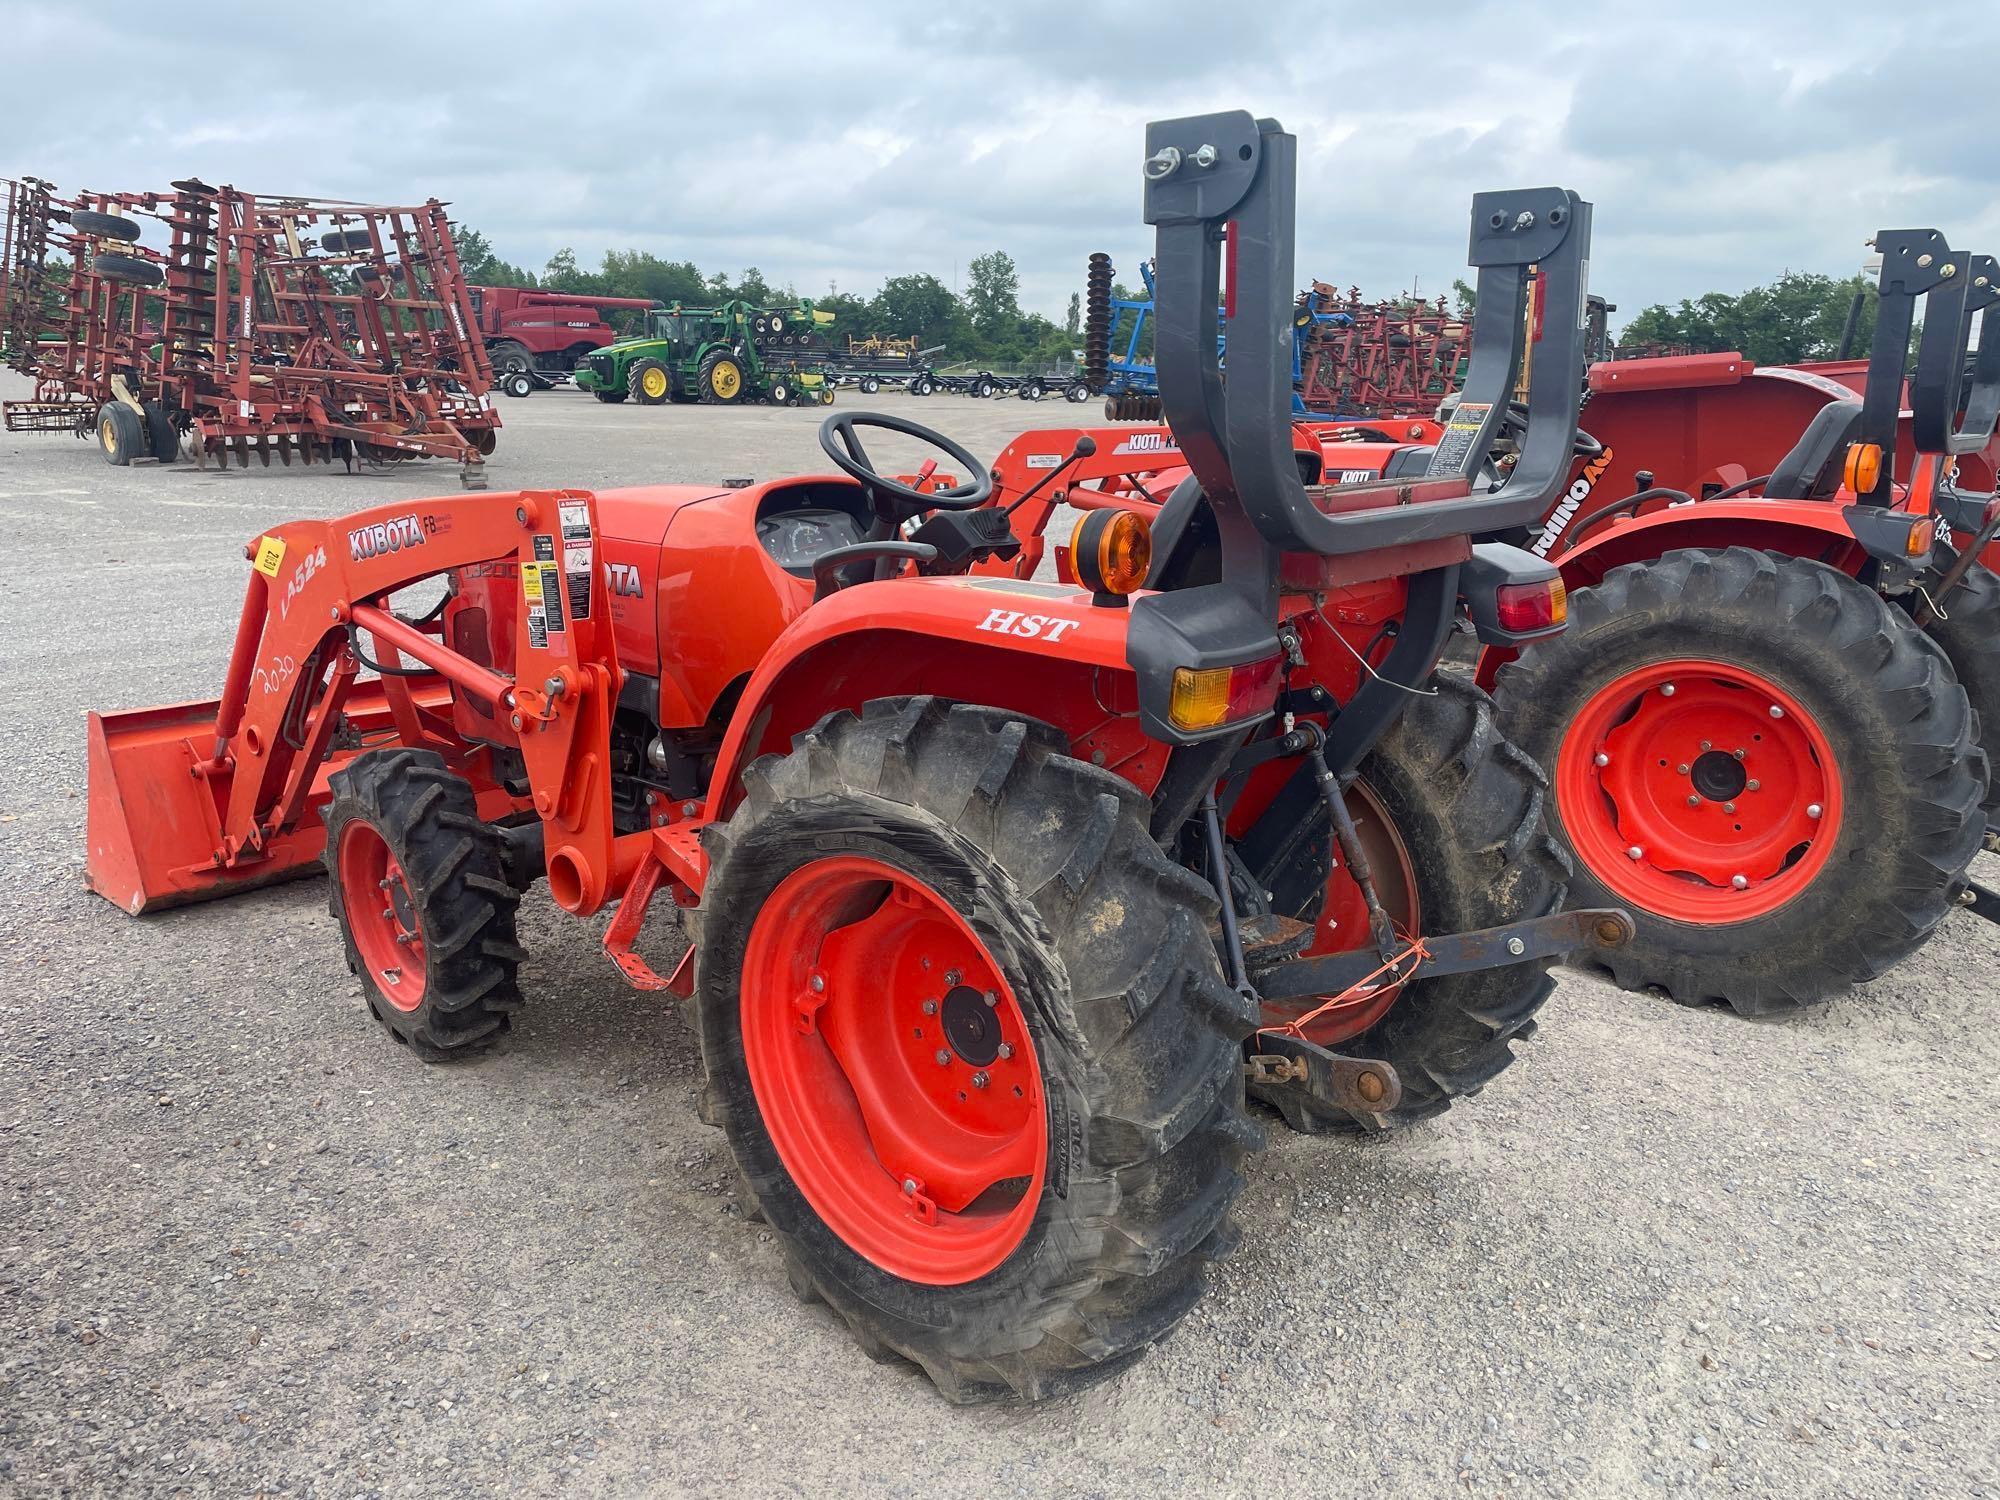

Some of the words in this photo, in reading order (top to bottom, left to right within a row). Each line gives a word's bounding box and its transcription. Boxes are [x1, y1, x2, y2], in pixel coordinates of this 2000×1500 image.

[1128, 433, 1161, 451] KIOTI
[1340, 470, 1370, 484] KIOTI
[1531, 479, 1591, 558] RHINO
[1583, 446, 1614, 487] AG
[347, 513, 427, 562] KUBOTA
[423, 515, 436, 536] FB
[280, 546, 327, 617] LA524
[976, 608, 1080, 643] HST
[256, 655, 294, 694] 2030
[1069, 1111, 1081, 1175] NYLON
